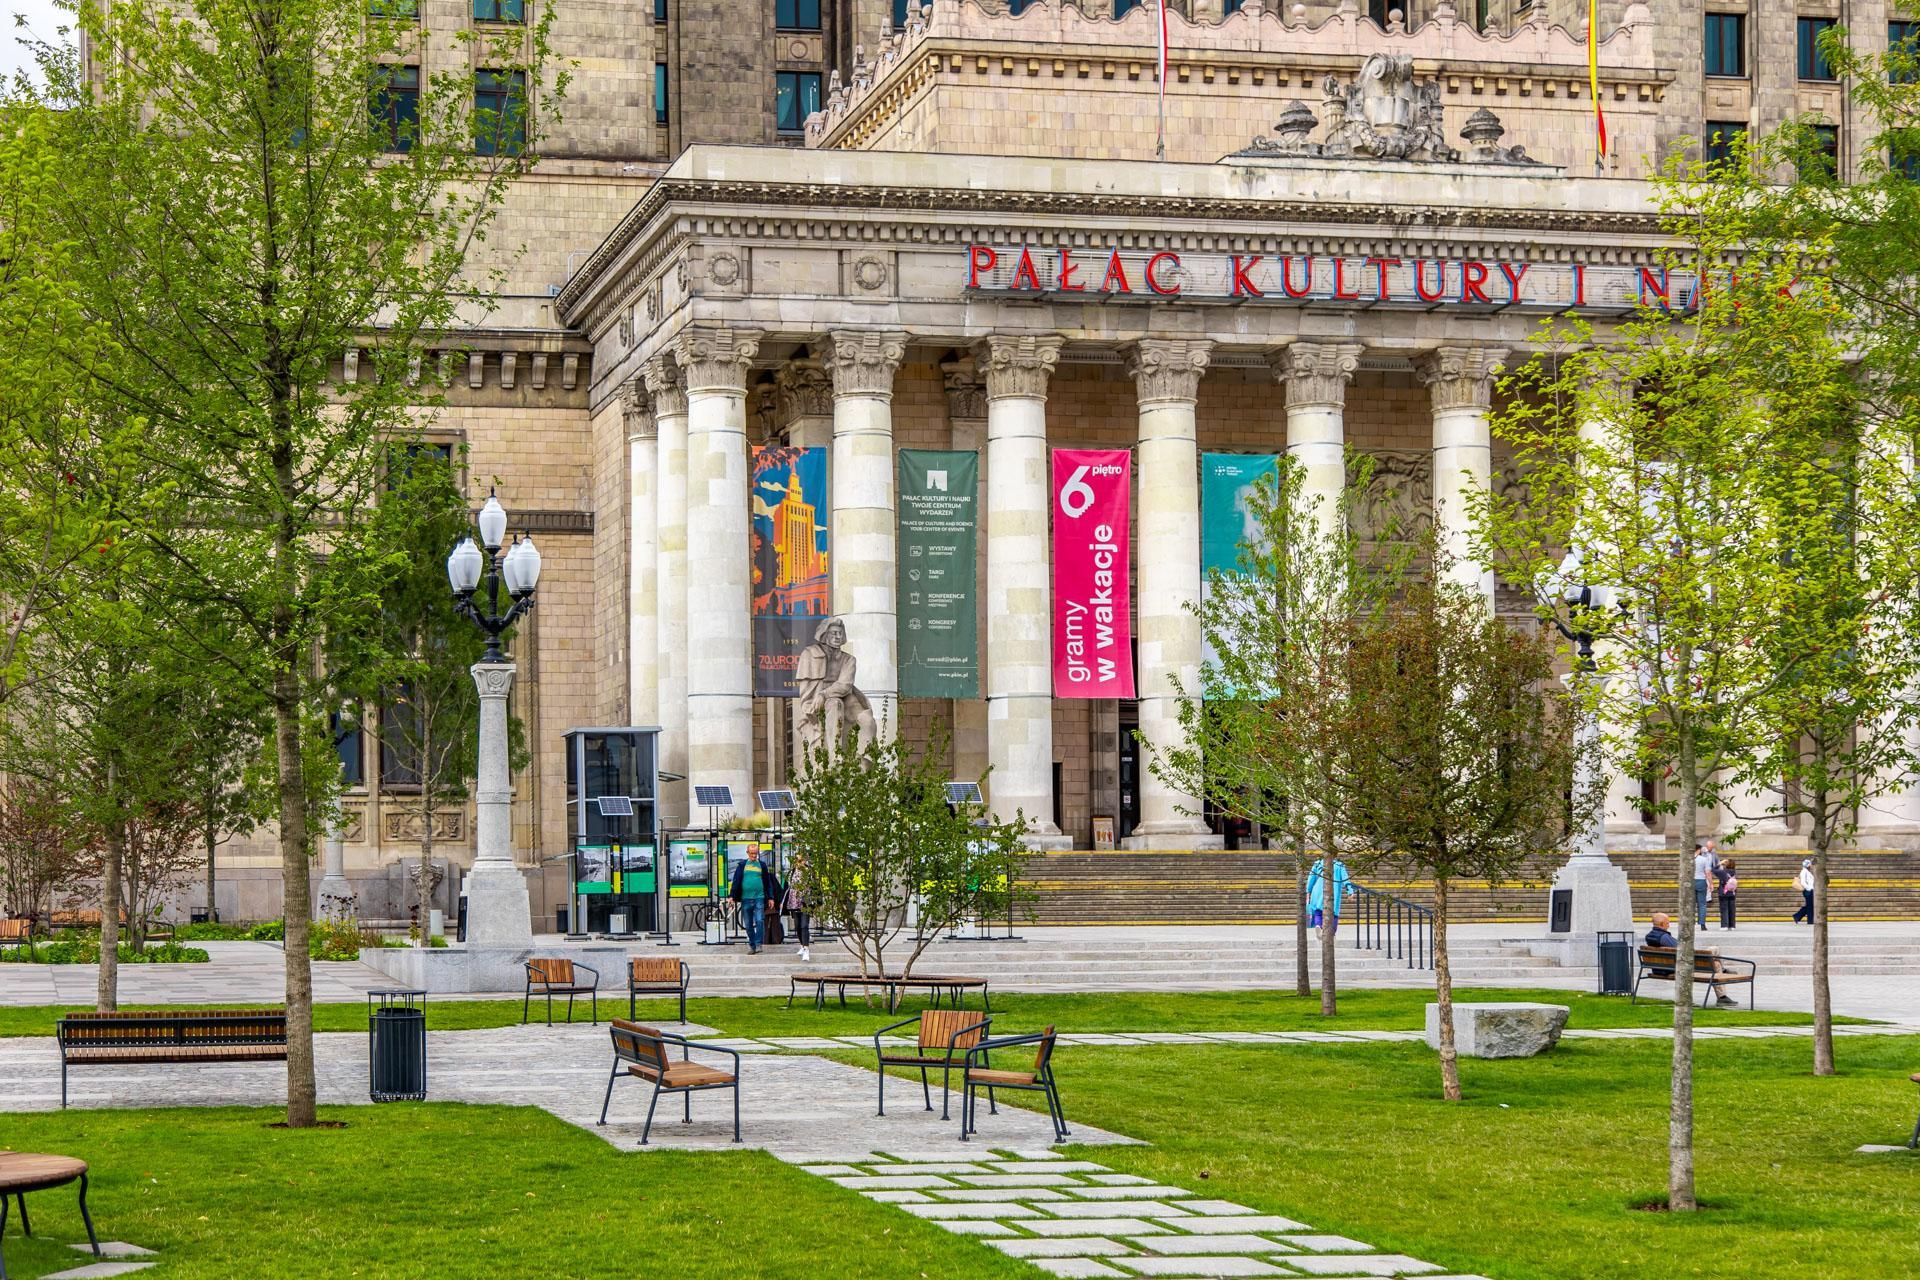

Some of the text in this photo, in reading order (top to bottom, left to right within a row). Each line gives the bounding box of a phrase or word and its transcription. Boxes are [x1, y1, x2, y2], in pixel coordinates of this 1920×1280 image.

[966, 244, 1182, 295] PAŁAC
[1229, 254, 1532, 305] KULTURY
[1571, 263, 1588, 306] I
[1060, 464, 1122, 519] 6 piętro
[1089, 524, 1118, 683] w wakacje
[1066, 600, 1090, 682] gramy
